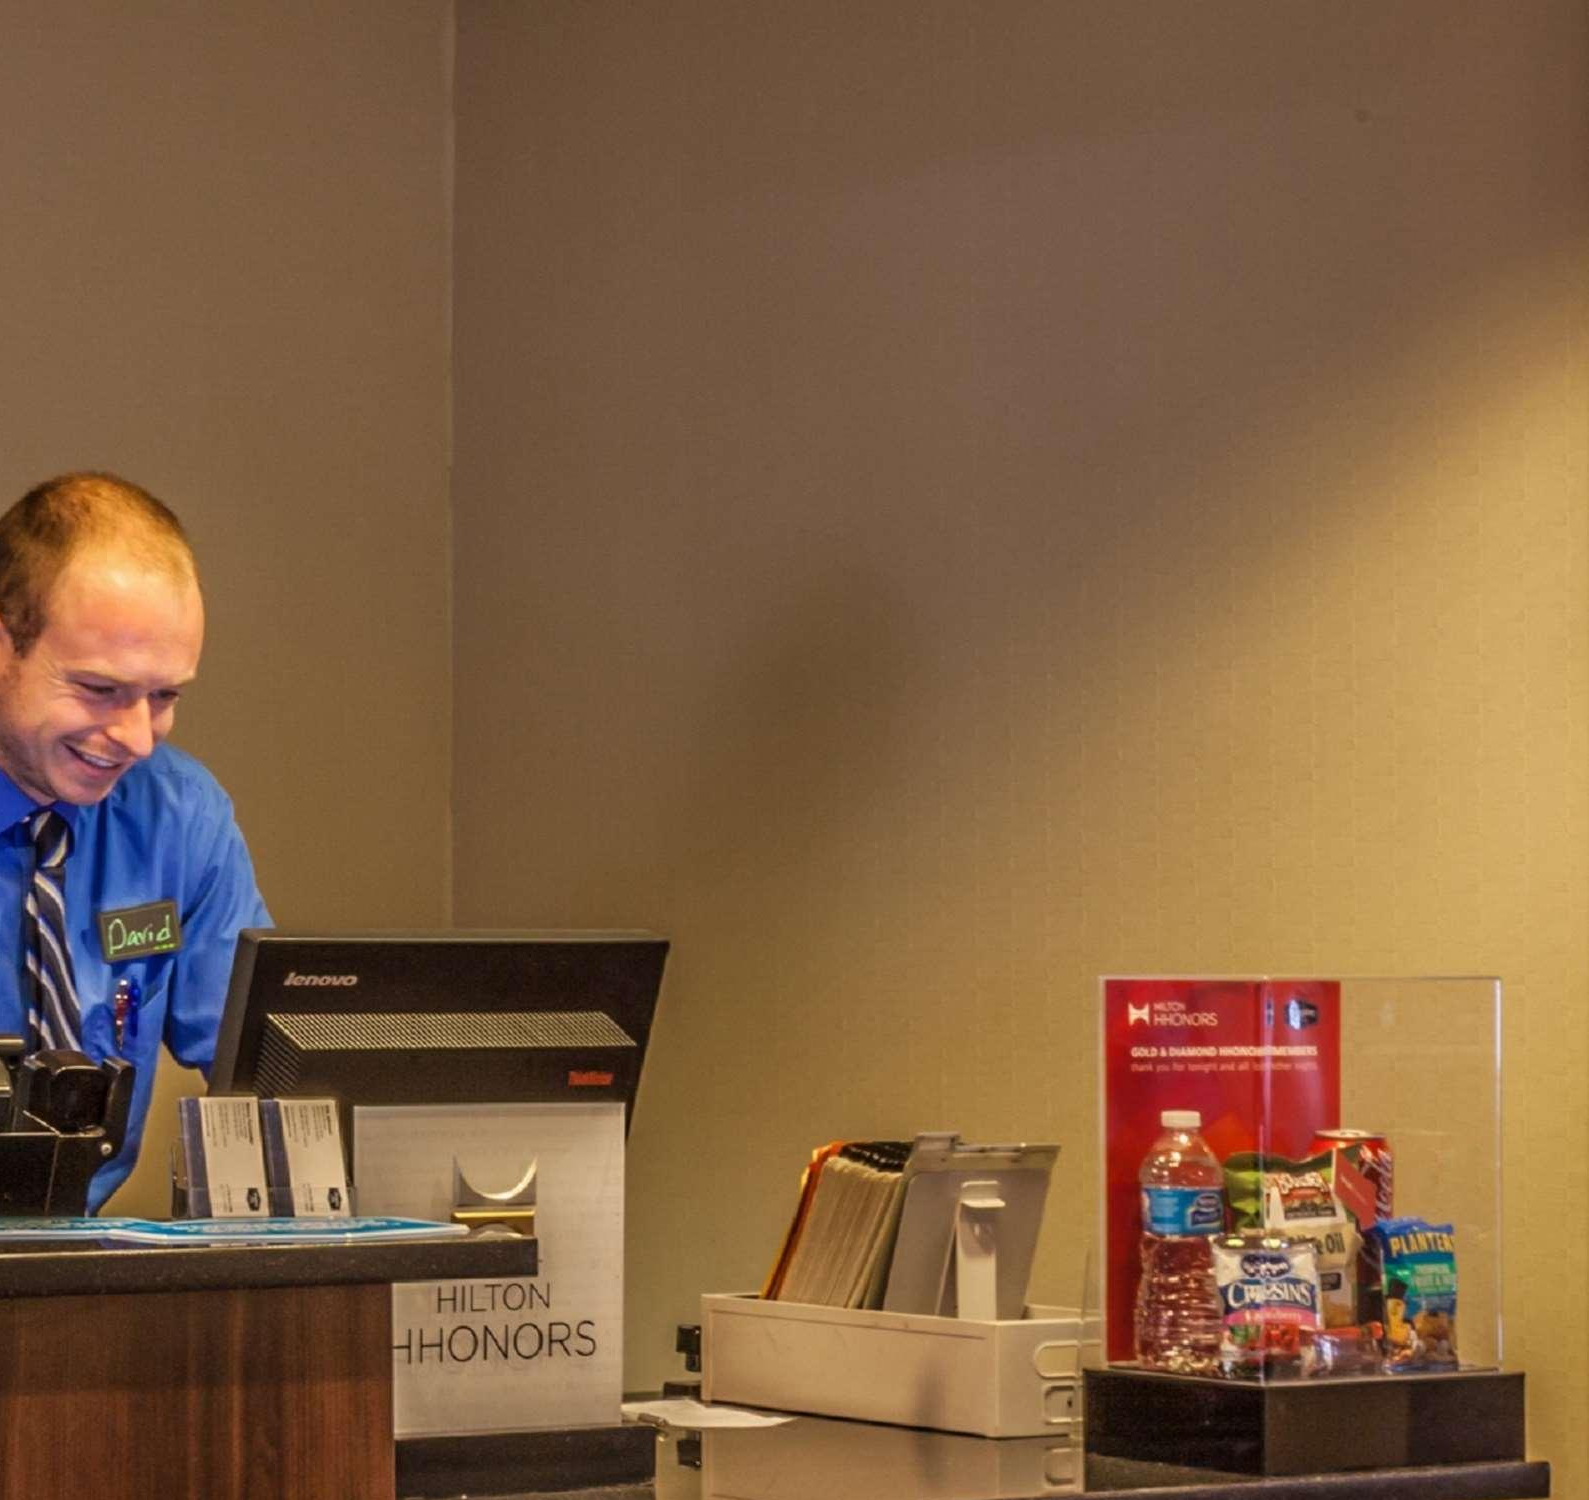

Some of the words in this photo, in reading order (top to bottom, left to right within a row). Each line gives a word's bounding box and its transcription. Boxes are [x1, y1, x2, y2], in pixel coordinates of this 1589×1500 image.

[109, 914, 172, 955] David
[283, 971, 358, 987] lenovo
[1153, 1001, 1186, 1011] HILTON
[1154, 1013, 1218, 1026] HHONORS
[1130, 1046, 1158, 1057] GOLD
[1169, 1046, 1217, 1056] DIAMOND
[1219, 1062, 1235, 1072] and
[1325, 1232, 1346, 1254] Oil
[437, 1282, 550, 1313] HILTON
[393, 1320, 597, 1364] HHONORS
